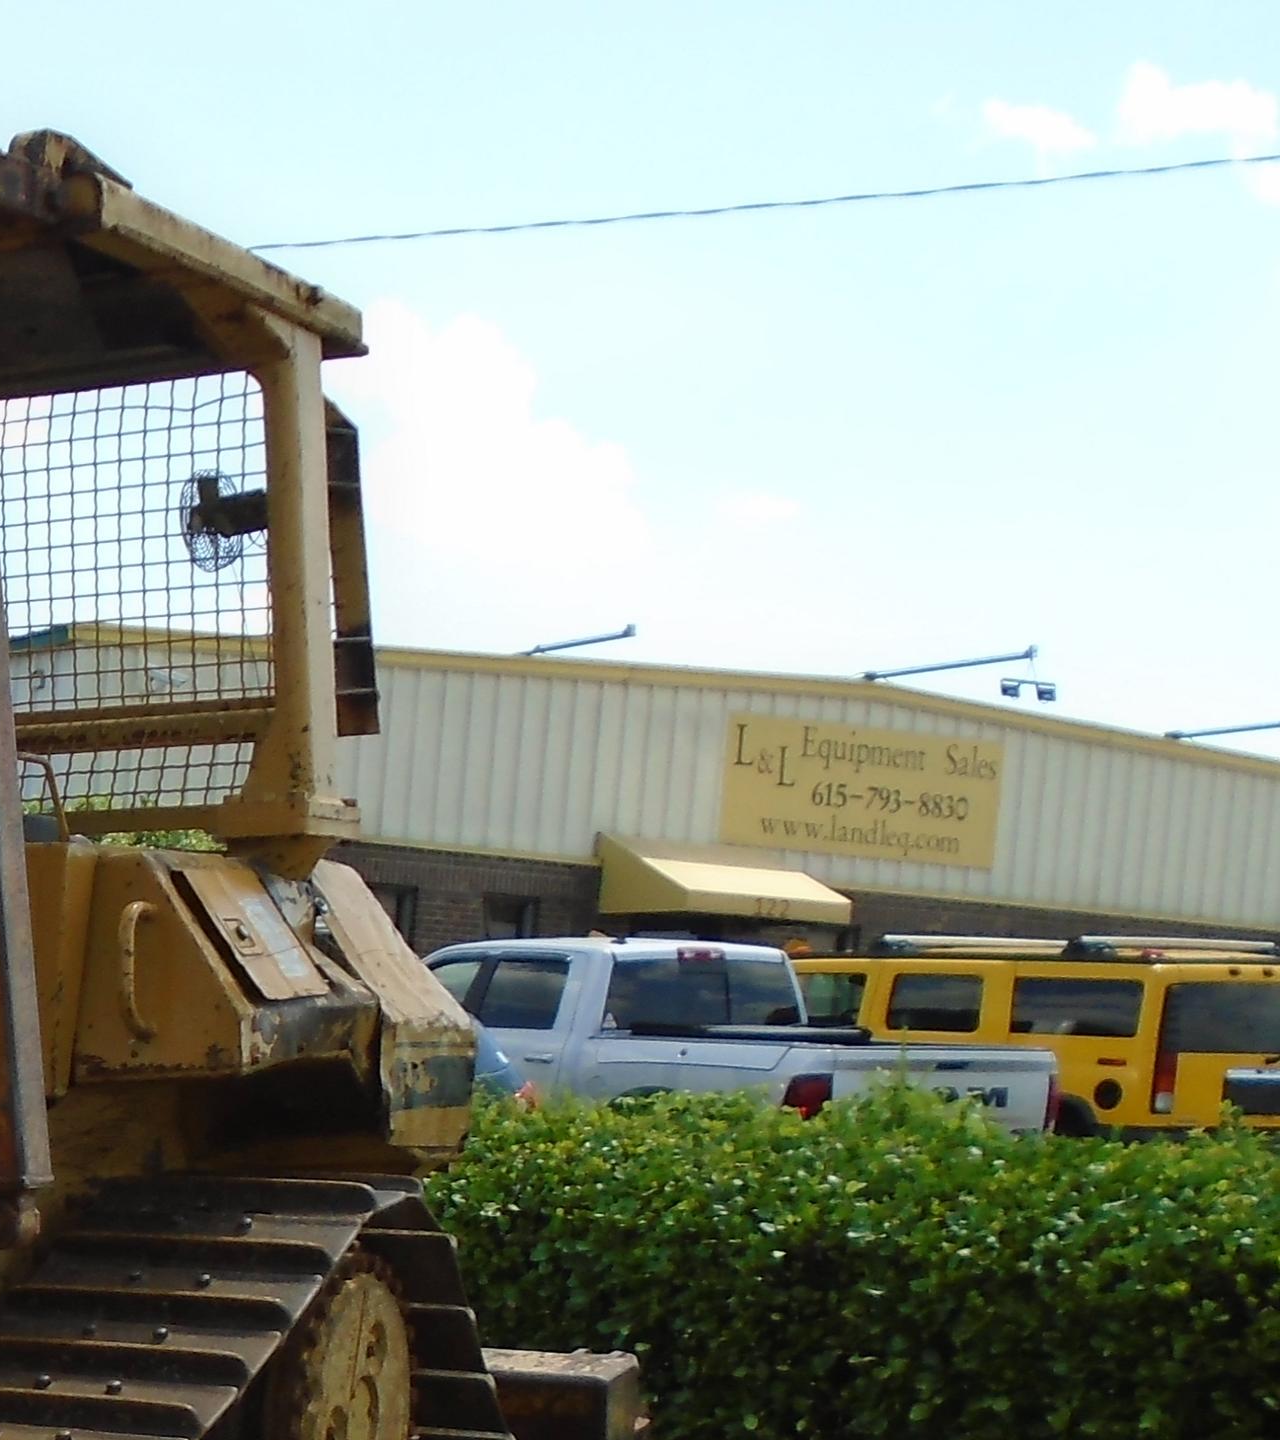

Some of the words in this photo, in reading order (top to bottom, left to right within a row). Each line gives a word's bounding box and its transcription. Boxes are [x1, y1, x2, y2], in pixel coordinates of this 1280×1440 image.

[734, 724, 795, 788] L&L
[801, 725, 927, 774] Equipment
[944, 743, 998, 781] Sales
[811, 781, 970, 821] 615-793-8830
